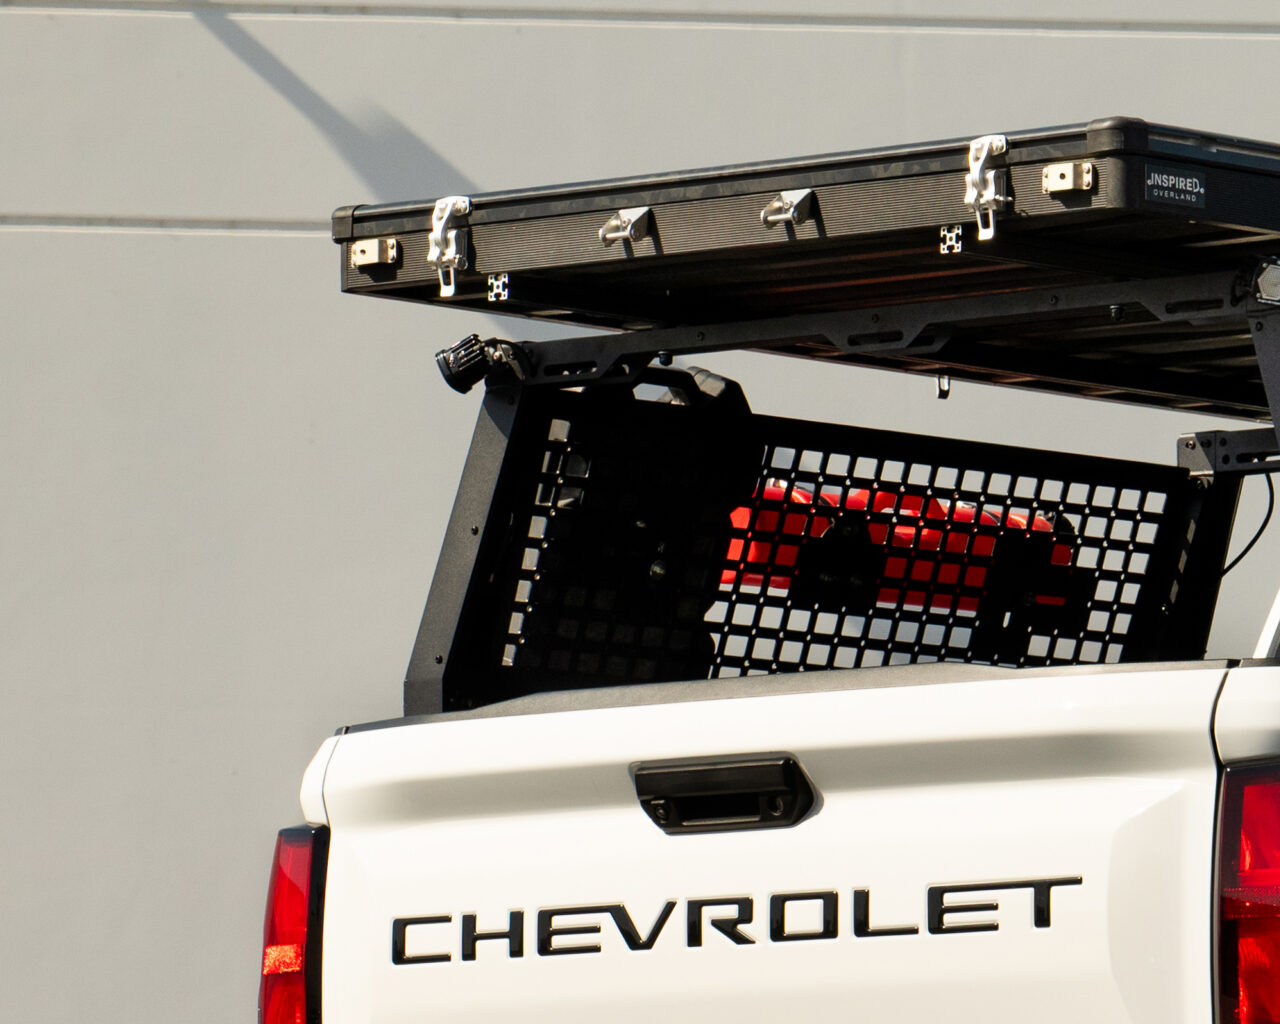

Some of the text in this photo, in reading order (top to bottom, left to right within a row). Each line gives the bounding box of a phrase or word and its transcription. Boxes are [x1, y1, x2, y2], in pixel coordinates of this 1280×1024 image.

[1151, 172, 1200, 192] INSPIRED
[1153, 189, 1197, 202] OVERLAND
[391, 875, 1084, 966] CHEVROLET
